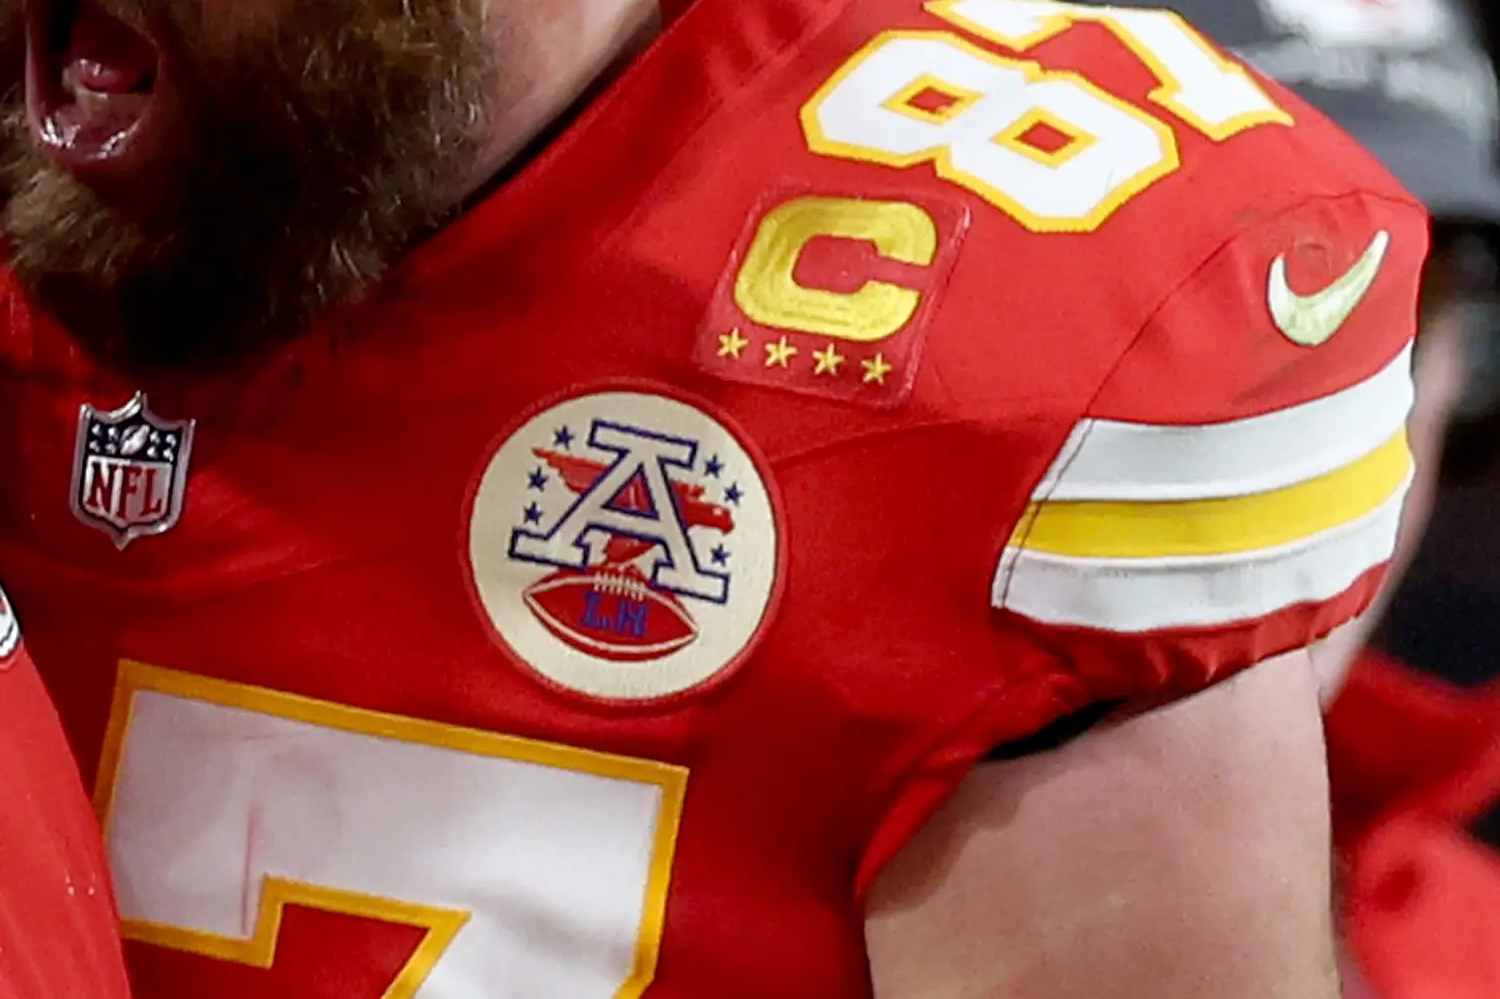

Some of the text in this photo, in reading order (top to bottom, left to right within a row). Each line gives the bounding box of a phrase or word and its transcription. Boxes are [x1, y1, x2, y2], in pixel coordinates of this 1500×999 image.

[734, 197, 937, 342] C
[87, 464, 164, 522] NFL
[508, 419, 730, 605] A
